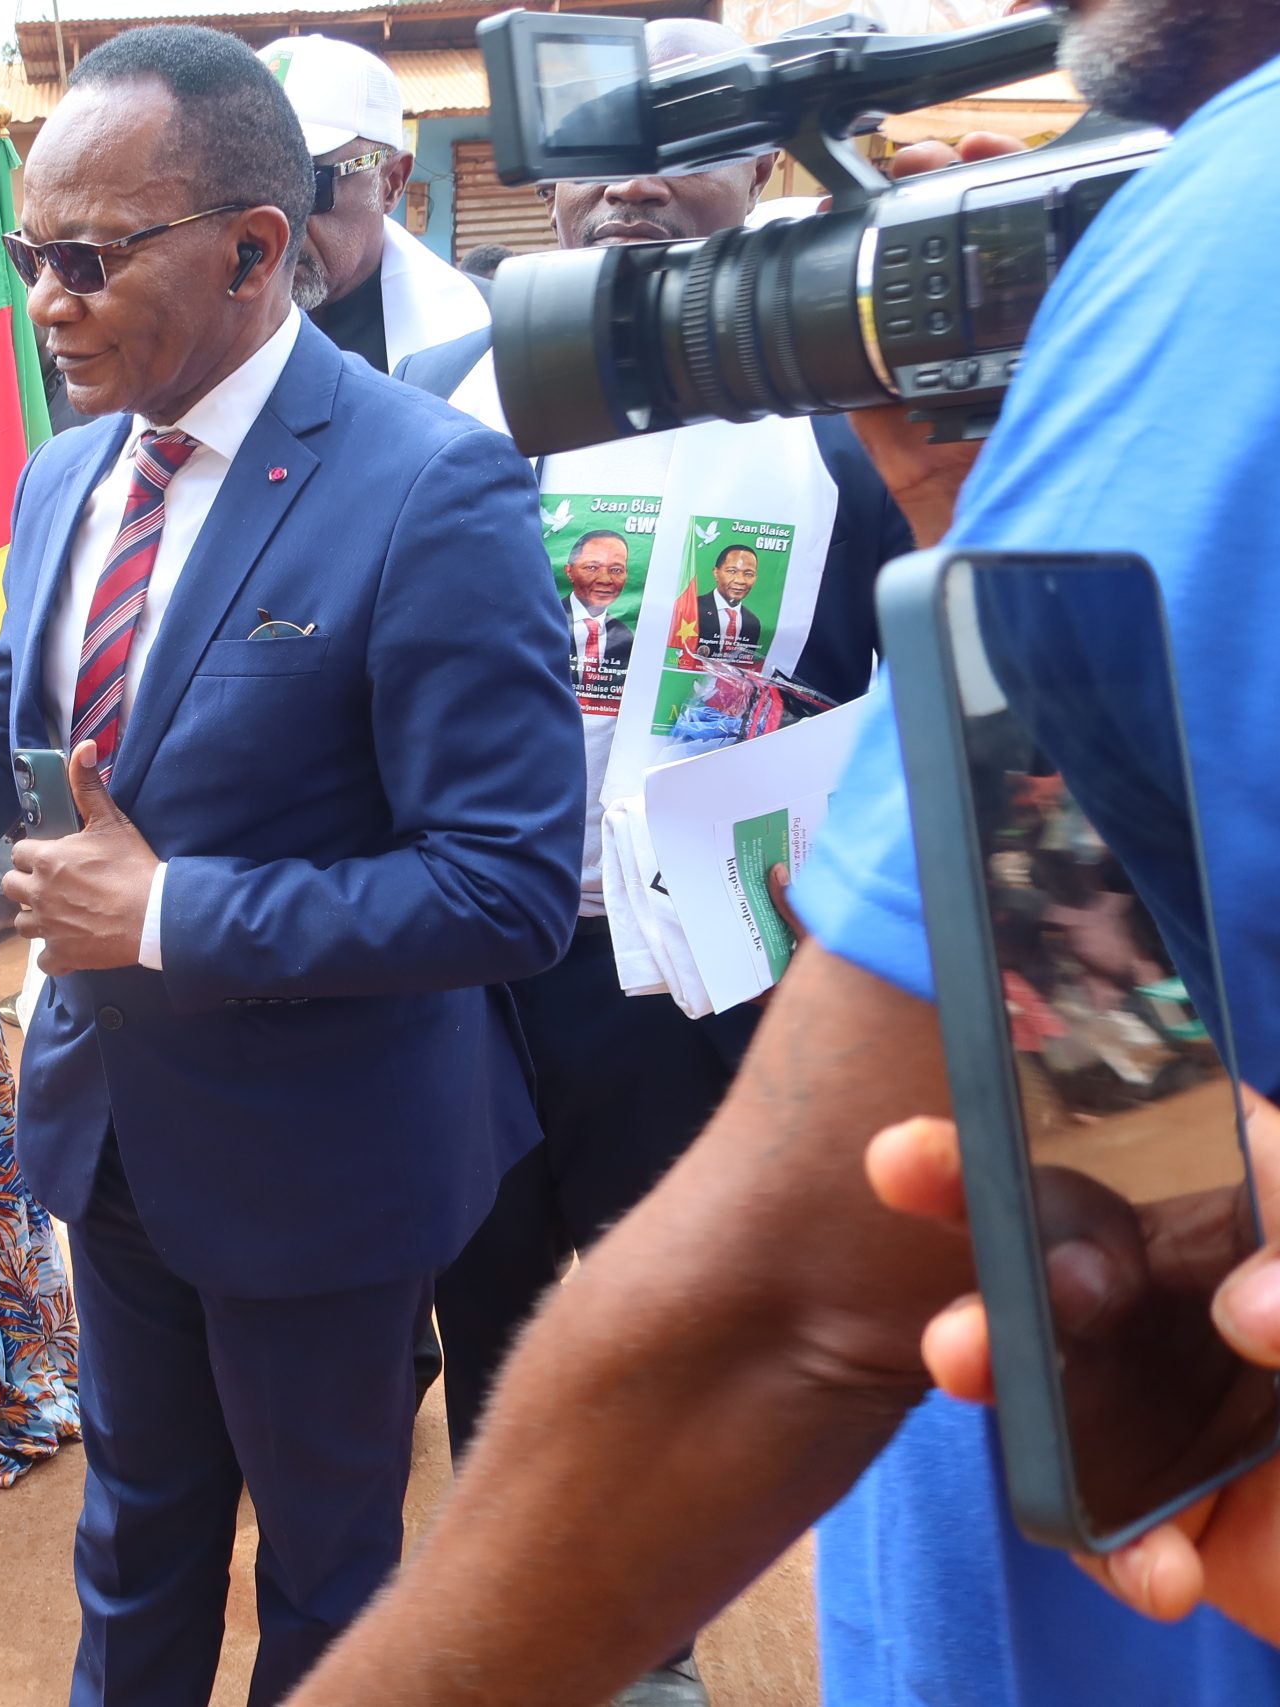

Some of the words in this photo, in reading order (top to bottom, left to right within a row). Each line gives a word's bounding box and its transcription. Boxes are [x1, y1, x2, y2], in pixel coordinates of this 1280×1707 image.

[590, 497, 628, 512] Jean
[630, 498, 661, 514] Blai
[624, 515, 657, 535] GW
[731, 521, 758, 534] Jean
[759, 524, 790, 538] Blaise
[755, 536, 790, 552] GWET
[610, 657, 621, 665] La
[572, 683, 585, 691] ean
[586, 683, 609, 693] Blaise
[610, 685, 625, 694] GW
[790, 817, 801, 861] Rejoignez
[726, 856, 763, 952] https://mpcc.be
